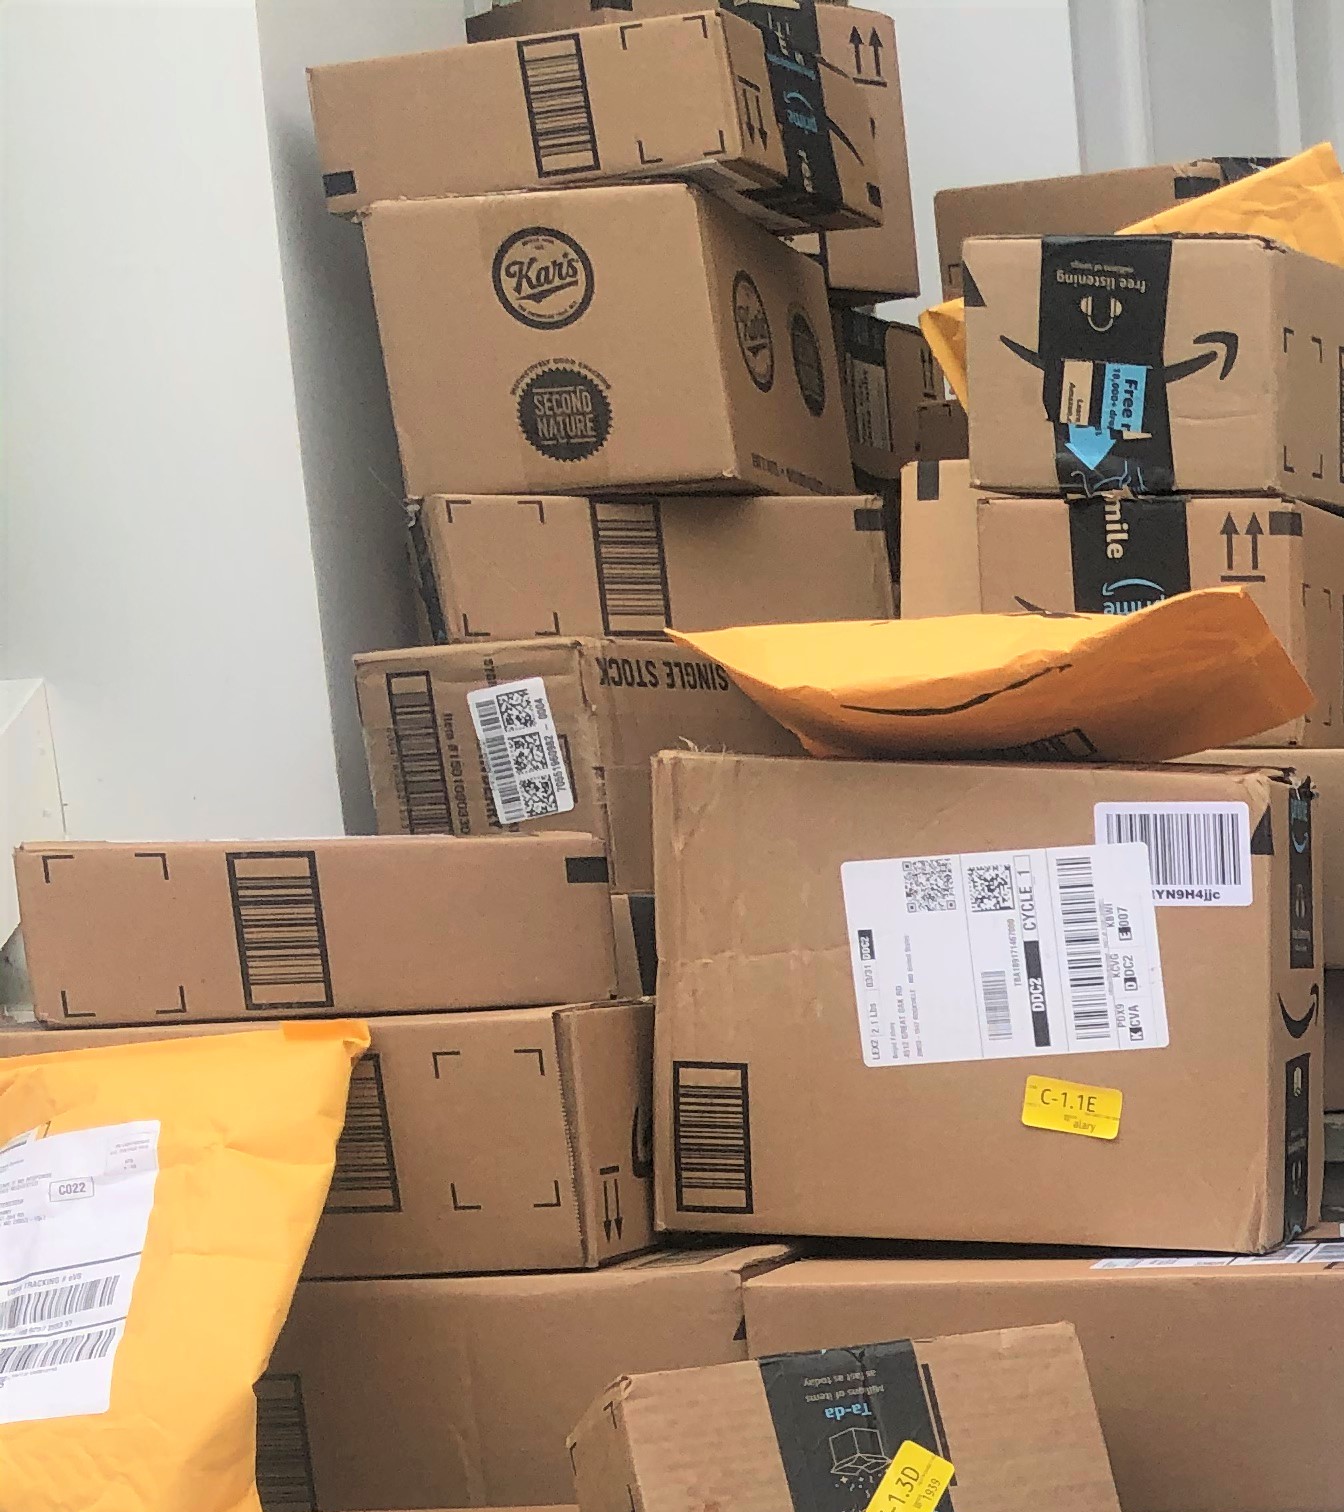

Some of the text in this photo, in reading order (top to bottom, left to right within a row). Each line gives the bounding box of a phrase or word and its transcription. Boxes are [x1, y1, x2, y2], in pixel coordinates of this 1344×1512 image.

[505, 252, 580, 295] Kar's
[533, 387, 592, 415] SECOND
[1121, 378, 1138, 420] Free
[537, 414, 597, 441] NATURE
[1103, 497, 1131, 560] mile
[596, 656, 729, 691] SINGLE STOCK
[1018, 886, 1037, 931] CYCLE
[860, 936, 872, 960] DDC2
[1029, 977, 1045, 1012] DDC2
[1116, 1003, 1126, 1029] PDX9
[1128, 1004, 1144, 1041] KCVA
[1040, 1088, 1098, 1114] C-1.1E
[58, 1182, 87, 1196] C022
[803, 1373, 833, 1389] today
[824, 1402, 872, 1421] Ta-da
[922, 1477, 942, 1503] 1939
